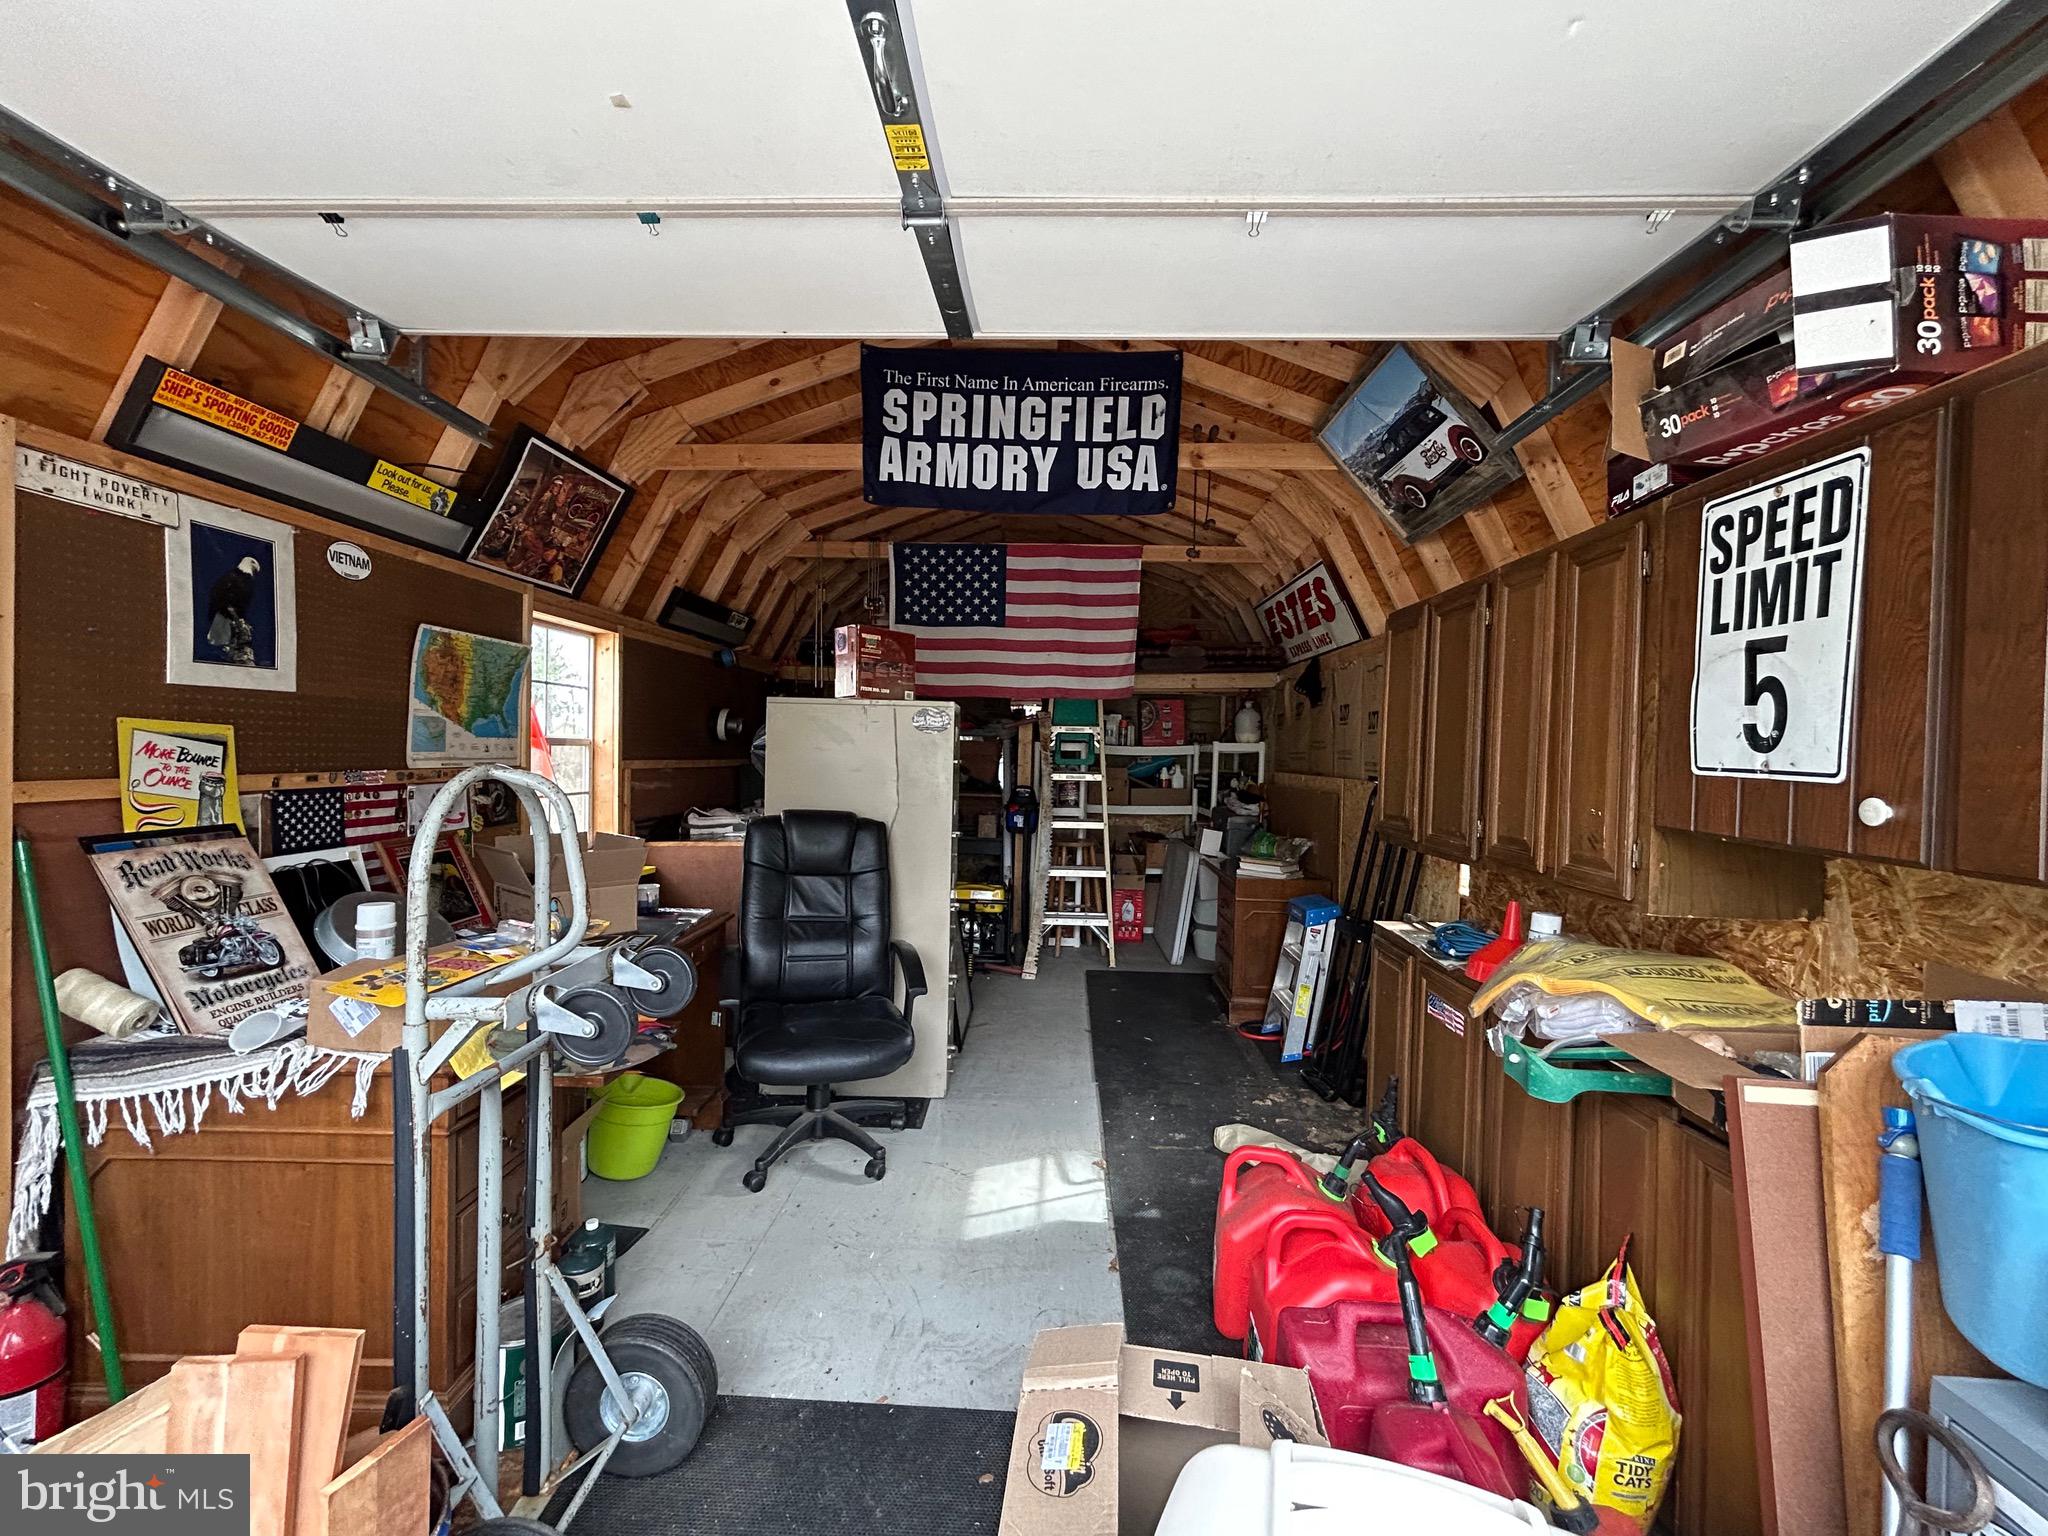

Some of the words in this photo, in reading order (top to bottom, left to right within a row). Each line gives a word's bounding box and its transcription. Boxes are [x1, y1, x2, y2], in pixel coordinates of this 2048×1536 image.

[883, 369, 913, 386] The
[916, 371, 951, 389] First
[954, 373, 999, 390] Name
[1003, 376, 1019, 391] In
[1022, 376, 1096, 393] American
[1099, 377, 1170, 392] Firearms.
[160, 379, 203, 404] SHEP'S
[202, 395, 259, 426] SPORTING
[258, 419, 294, 441] GOODS
[167, 370, 194, 386] CRIME
[233, 398, 250, 409] NOT
[250, 403, 266, 415] GUN
[265, 411, 298, 429] CONTROL
[226, 419, 250, 434] (304)
[882, 388, 1168, 443] SPRINGFIELD
[376, 464, 398, 480] Look
[397, 475, 412, 487] out
[411, 478, 423, 490] for
[878, 435, 1059, 493] ARMORY
[24, 454, 30, 467] I
[39, 458, 91, 485] FIGHT
[99, 476, 170, 507] POVERTY
[82, 486, 88, 498] I
[381, 479, 411, 499] Please.
[1610, 489, 1631, 508] FILA
[1709, 475, 1854, 576] SPEED
[328, 548, 371, 571] VIETNAM
[1709, 549, 1843, 636] LIMIT
[1263, 576, 1337, 645] ESTES
[1288, 639, 1314, 659] EXPRESS
[1312, 631, 1334, 649] LINES
[1742, 634, 1789, 755] 5
[134, 740, 177, 761] MORE
[175, 745, 221, 768] BOUNCE
[143, 767, 193, 791] OUNCE
[159, 762, 172, 773] TO
[174, 765, 192, 776] THE
[115, 853, 177, 890] Road
[173, 848, 252, 872] Works
[142, 913, 196, 938] WORLD
[237, 897, 279, 917] CLASS
[184, 965, 310, 1013] Motorcycles
[209, 999, 255, 1020] ENGINE
[252, 983, 305, 1005] BUILDERS
[1156, 1372, 1176, 1382] HERE
[1161, 1367, 1181, 1378] OPEN
[1179, 1375, 1197, 1385] PULL
[1181, 1368, 1193, 1379] TO
[1613, 1473, 1653, 1489] CATS
[1615, 1461, 1654, 1478] TIDY
